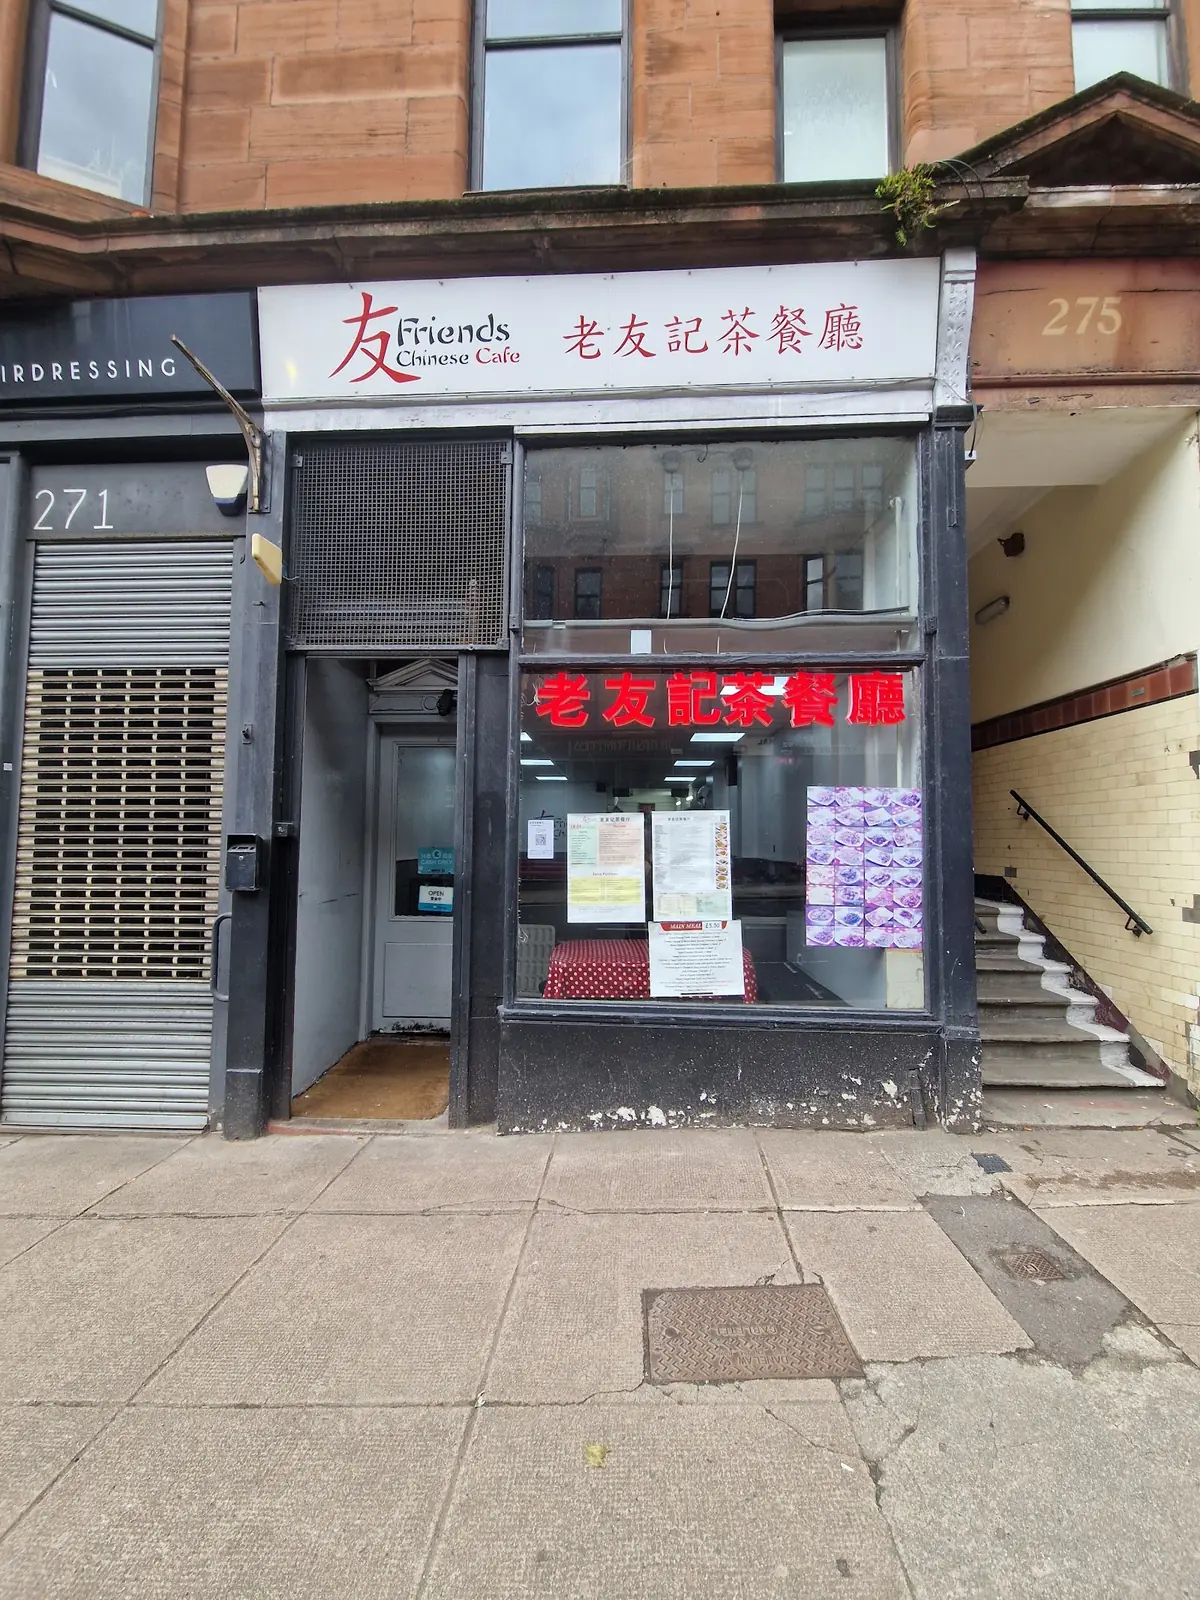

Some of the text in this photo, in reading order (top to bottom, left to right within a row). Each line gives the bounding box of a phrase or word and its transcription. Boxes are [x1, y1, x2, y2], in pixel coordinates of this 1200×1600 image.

[397, 312, 511, 347] Friends
[562, 301, 865, 360] 老友記茶餐廳
[1041, 296, 1123, 336] 275
[328, 291, 422, 384] 友
[1, 358, 178, 384] IRDRESSING
[396, 346, 521, 367] Chinese Cafe
[33, 488, 115, 531] 271
[535, 671, 906, 728] 老友記茶餐廳
[705, 921, 720, 929] £5.50
[737, 1356, 788, 1365] DANELAW
